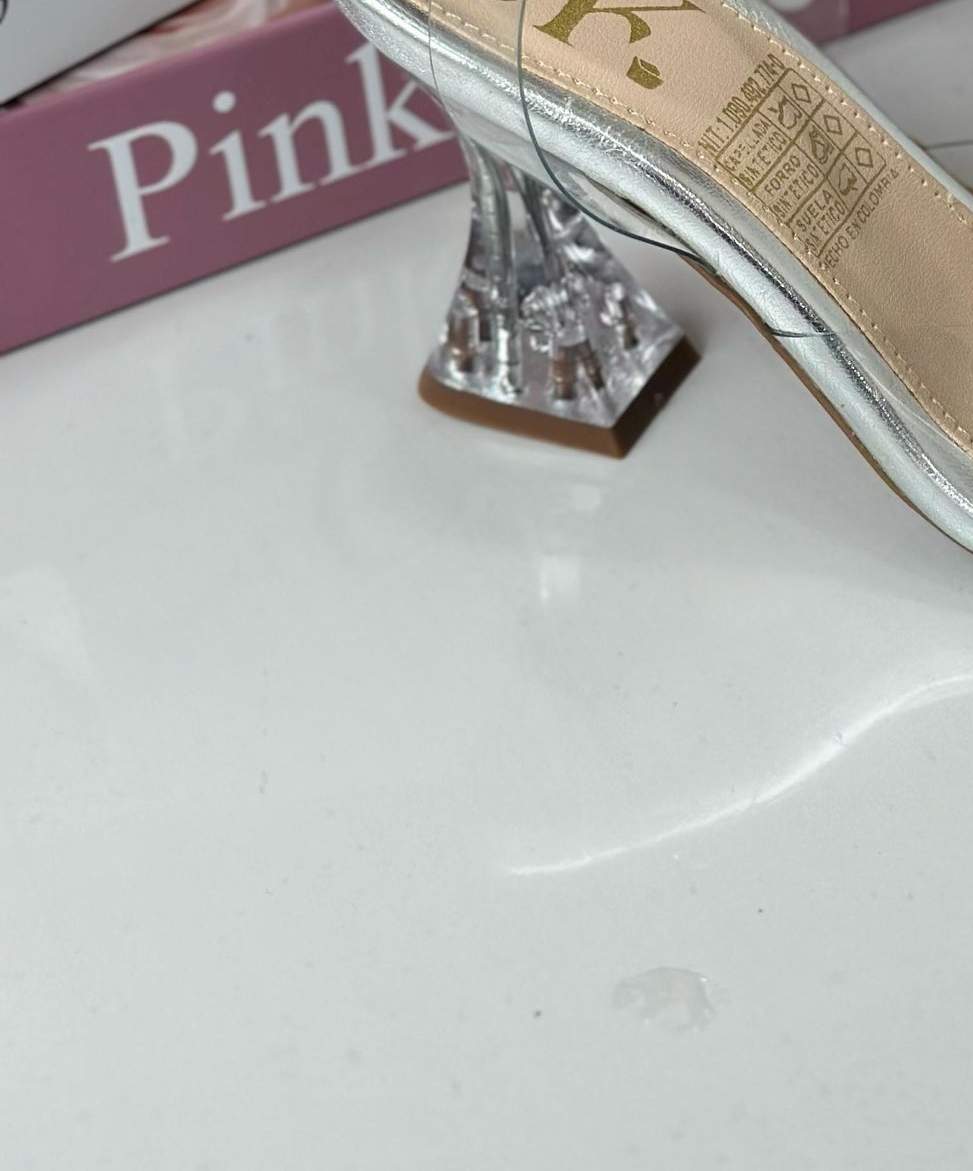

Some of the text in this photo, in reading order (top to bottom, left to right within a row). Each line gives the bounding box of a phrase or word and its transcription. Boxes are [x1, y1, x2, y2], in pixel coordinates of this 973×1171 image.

[88, 44, 458, 262] Pink
[764, 154, 801, 196] FORRO
[797, 189, 833, 233] SUELA
